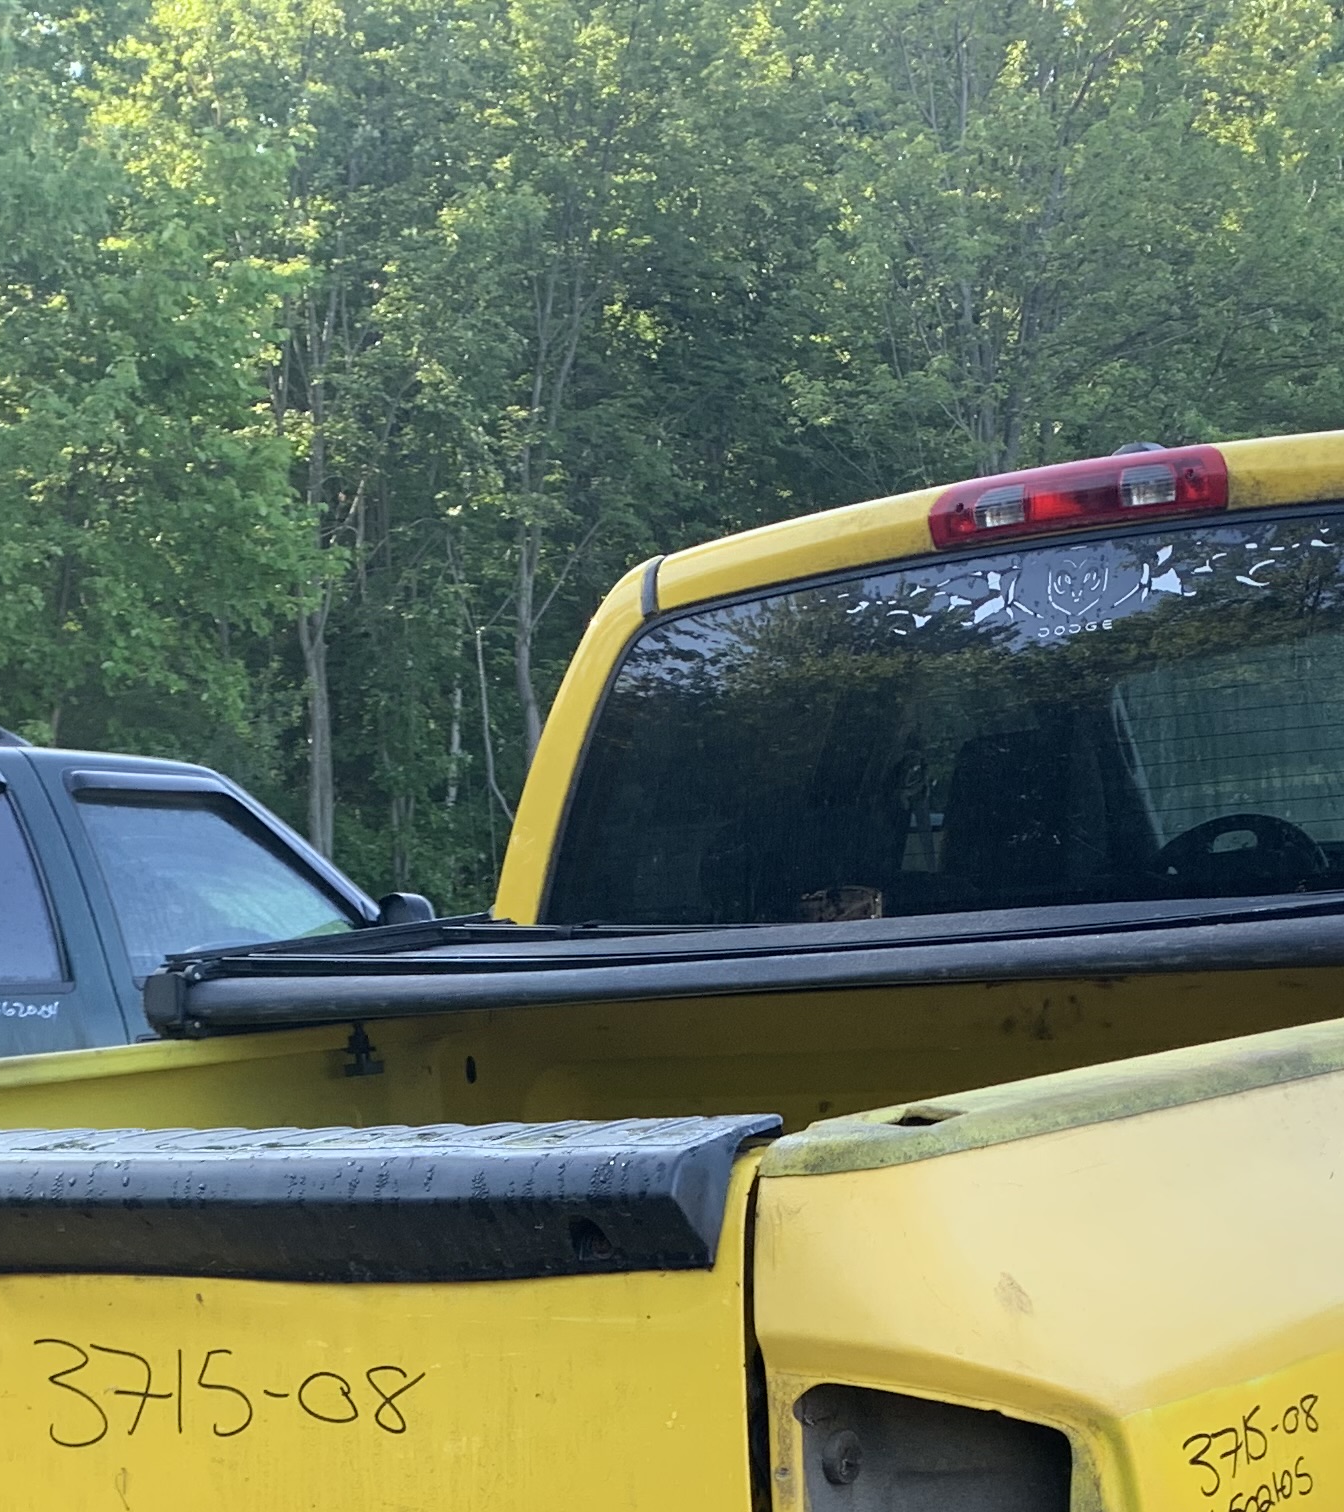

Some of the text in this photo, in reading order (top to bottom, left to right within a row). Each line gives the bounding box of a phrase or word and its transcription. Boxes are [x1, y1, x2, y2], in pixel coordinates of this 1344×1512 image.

[1037, 619, 1113, 638] DODGE
[33, 1338, 426, 1448] 3715-08
[1182, 1393, 1320, 1498] 3715-08
